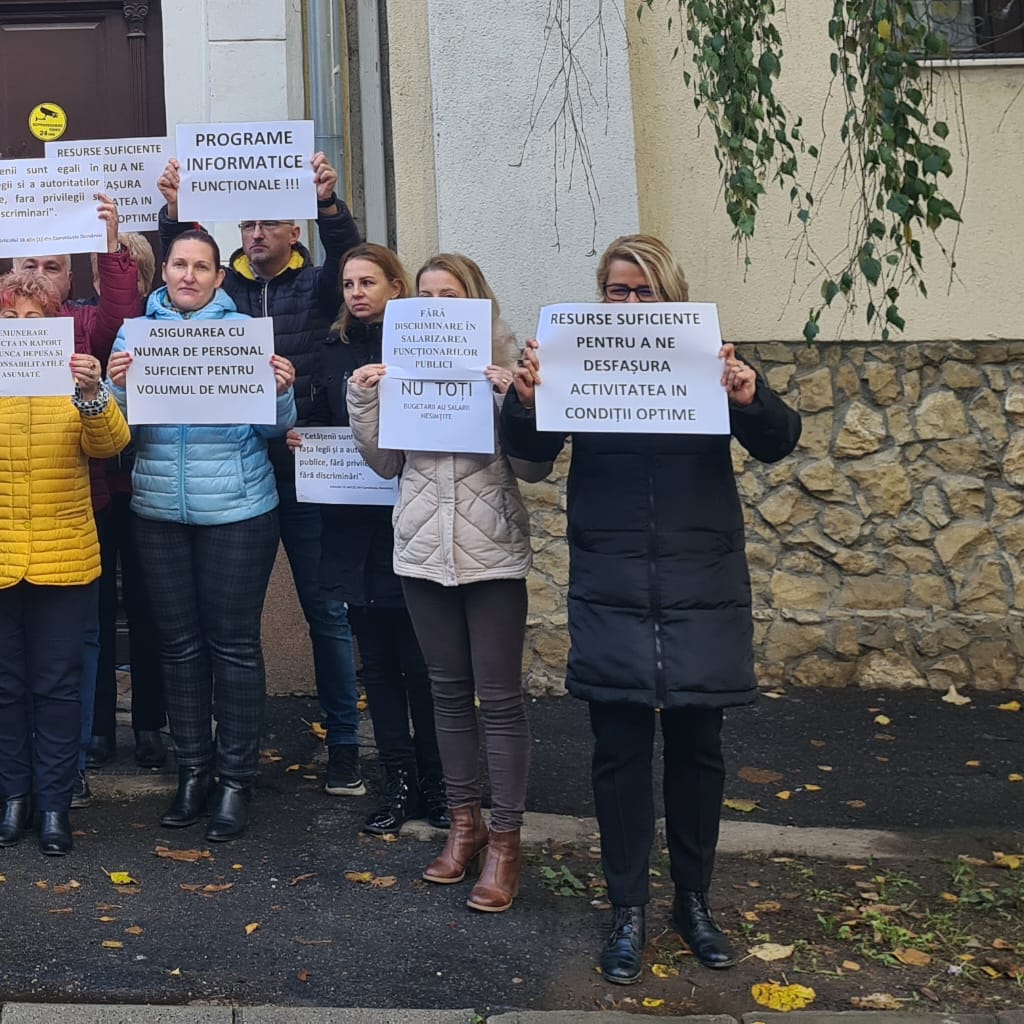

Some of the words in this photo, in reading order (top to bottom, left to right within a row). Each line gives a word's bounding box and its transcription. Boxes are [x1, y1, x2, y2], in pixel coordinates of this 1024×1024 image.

[195, 130, 294, 147] PROGRAME
[57, 146, 102, 158] RESURSE
[104, 144, 162, 156] SUFICIENTE
[120, 162, 128, 172] A
[130, 162, 144, 172] NE
[186, 154, 304, 172] INFORMATICE
[26, 166, 48, 174] sunt
[57, 164, 80, 175] egali
[17, 179, 25, 189] si
[29, 180, 36, 189] a
[40, 178, 100, 189] autoritatilor
[191, 179, 282, 194] FUNCȚIONALE
[285, 178, 300, 190] !!!
[16, 194, 35, 203] fara
[42, 192, 85, 204] privilegii
[141, 196, 152, 206] IN
[118, 212, 158, 224] OPTIME
[420, 308, 446, 318] FĂRĂ
[550, 312, 613, 326] RESURSE
[616, 312, 701, 326] SUFICIENTE
[394, 322, 464, 331] DISCRIMINARE
[465, 320, 477, 331] ÎN
[149, 327, 226, 338] ASIGURAREA
[228, 326, 246, 338] CU
[400, 334, 468, 344] SALARIZAREA
[576, 336, 636, 349] PENTRU
[640, 337, 652, 349] A
[655, 336, 676, 349] NE
[134, 346, 180, 357] NUMAR
[183, 346, 198, 357] DE
[202, 346, 264, 356] PERSONAL
[393, 347, 478, 358] FUNCȚIONARILOR
[415, 360, 453, 369] PUBLICI
[584, 359, 672, 375] DESFAȘURA
[144, 366, 204, 376] SUFICIENT
[208, 365, 254, 376] PENTRU
[136, 384, 196, 395] VOLUMUL
[199, 384, 215, 395] DE
[218, 384, 265, 394] MUNCA
[400, 380, 424, 396] NU
[434, 381, 473, 402] TOȚI
[570, 383, 668, 396] ACTIVITATEA
[671, 384, 688, 397] IN
[564, 406, 632, 423] CONDIȚII
[636, 408, 697, 422] OPTIME
[316, 446, 331, 454] legii
[300, 458, 328, 468] publice,
[300, 471, 314, 479] fără
